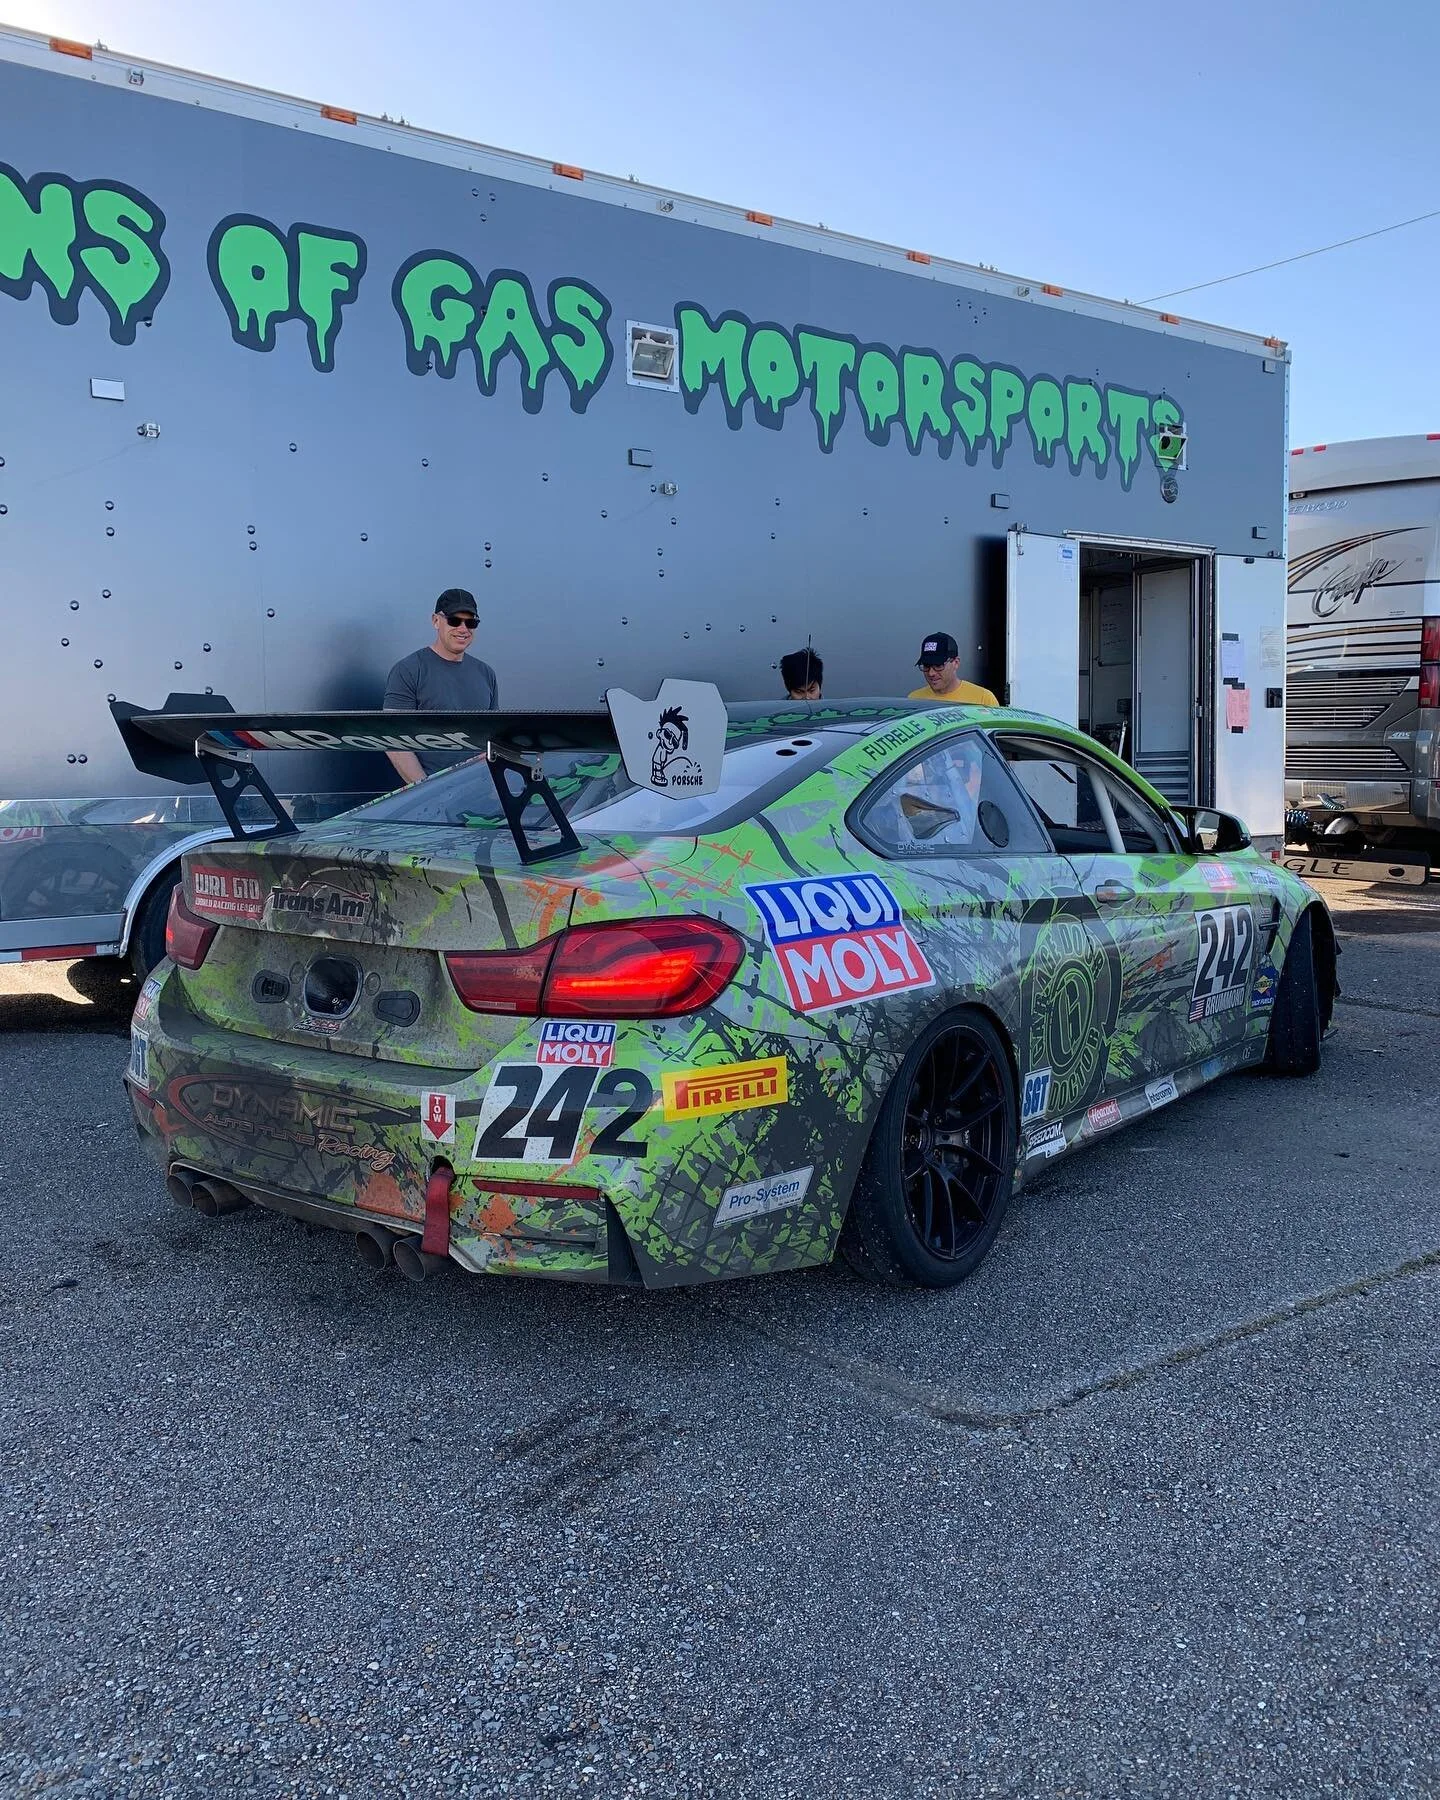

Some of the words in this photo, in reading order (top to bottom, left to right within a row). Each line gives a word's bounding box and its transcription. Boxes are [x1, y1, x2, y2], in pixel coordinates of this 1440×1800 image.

[211, 217, 363, 370] OF
[395, 252, 610, 406] GAS
[676, 303, 1183, 491] MOTORSPORTS
[862, 719, 925, 761] FUTRELLE
[671, 774, 703, 786] PORSCHE
[194, 872, 230, 897] WRL
[232, 876, 261, 900] GTO
[1283, 858, 1354, 876] GLE
[213, 899, 236, 911] RACING
[236, 902, 263, 914] LEAGUE
[755, 878, 894, 937] LIQUI
[784, 930, 919, 1005] MOLY
[1194, 907, 1252, 999] 242
[1204, 987, 1245, 1017] BRUMMOND
[545, 1023, 612, 1043] LIQUI
[540, 1043, 611, 1064] MOLY
[1046, 1026, 1101, 1112] DOCTOR
[675, 1067, 778, 1110] PIRELLI
[1023, 1074, 1050, 1118] SGT
[211, 1083, 360, 1135] DYNAMIC
[432, 1096, 442, 1123] TOW
[486, 1065, 655, 1161] 242
[1091, 1102, 1118, 1122] Heacock
[316, 1132, 397, 1172] Racing
[728, 1181, 800, 1209] Pro-System
